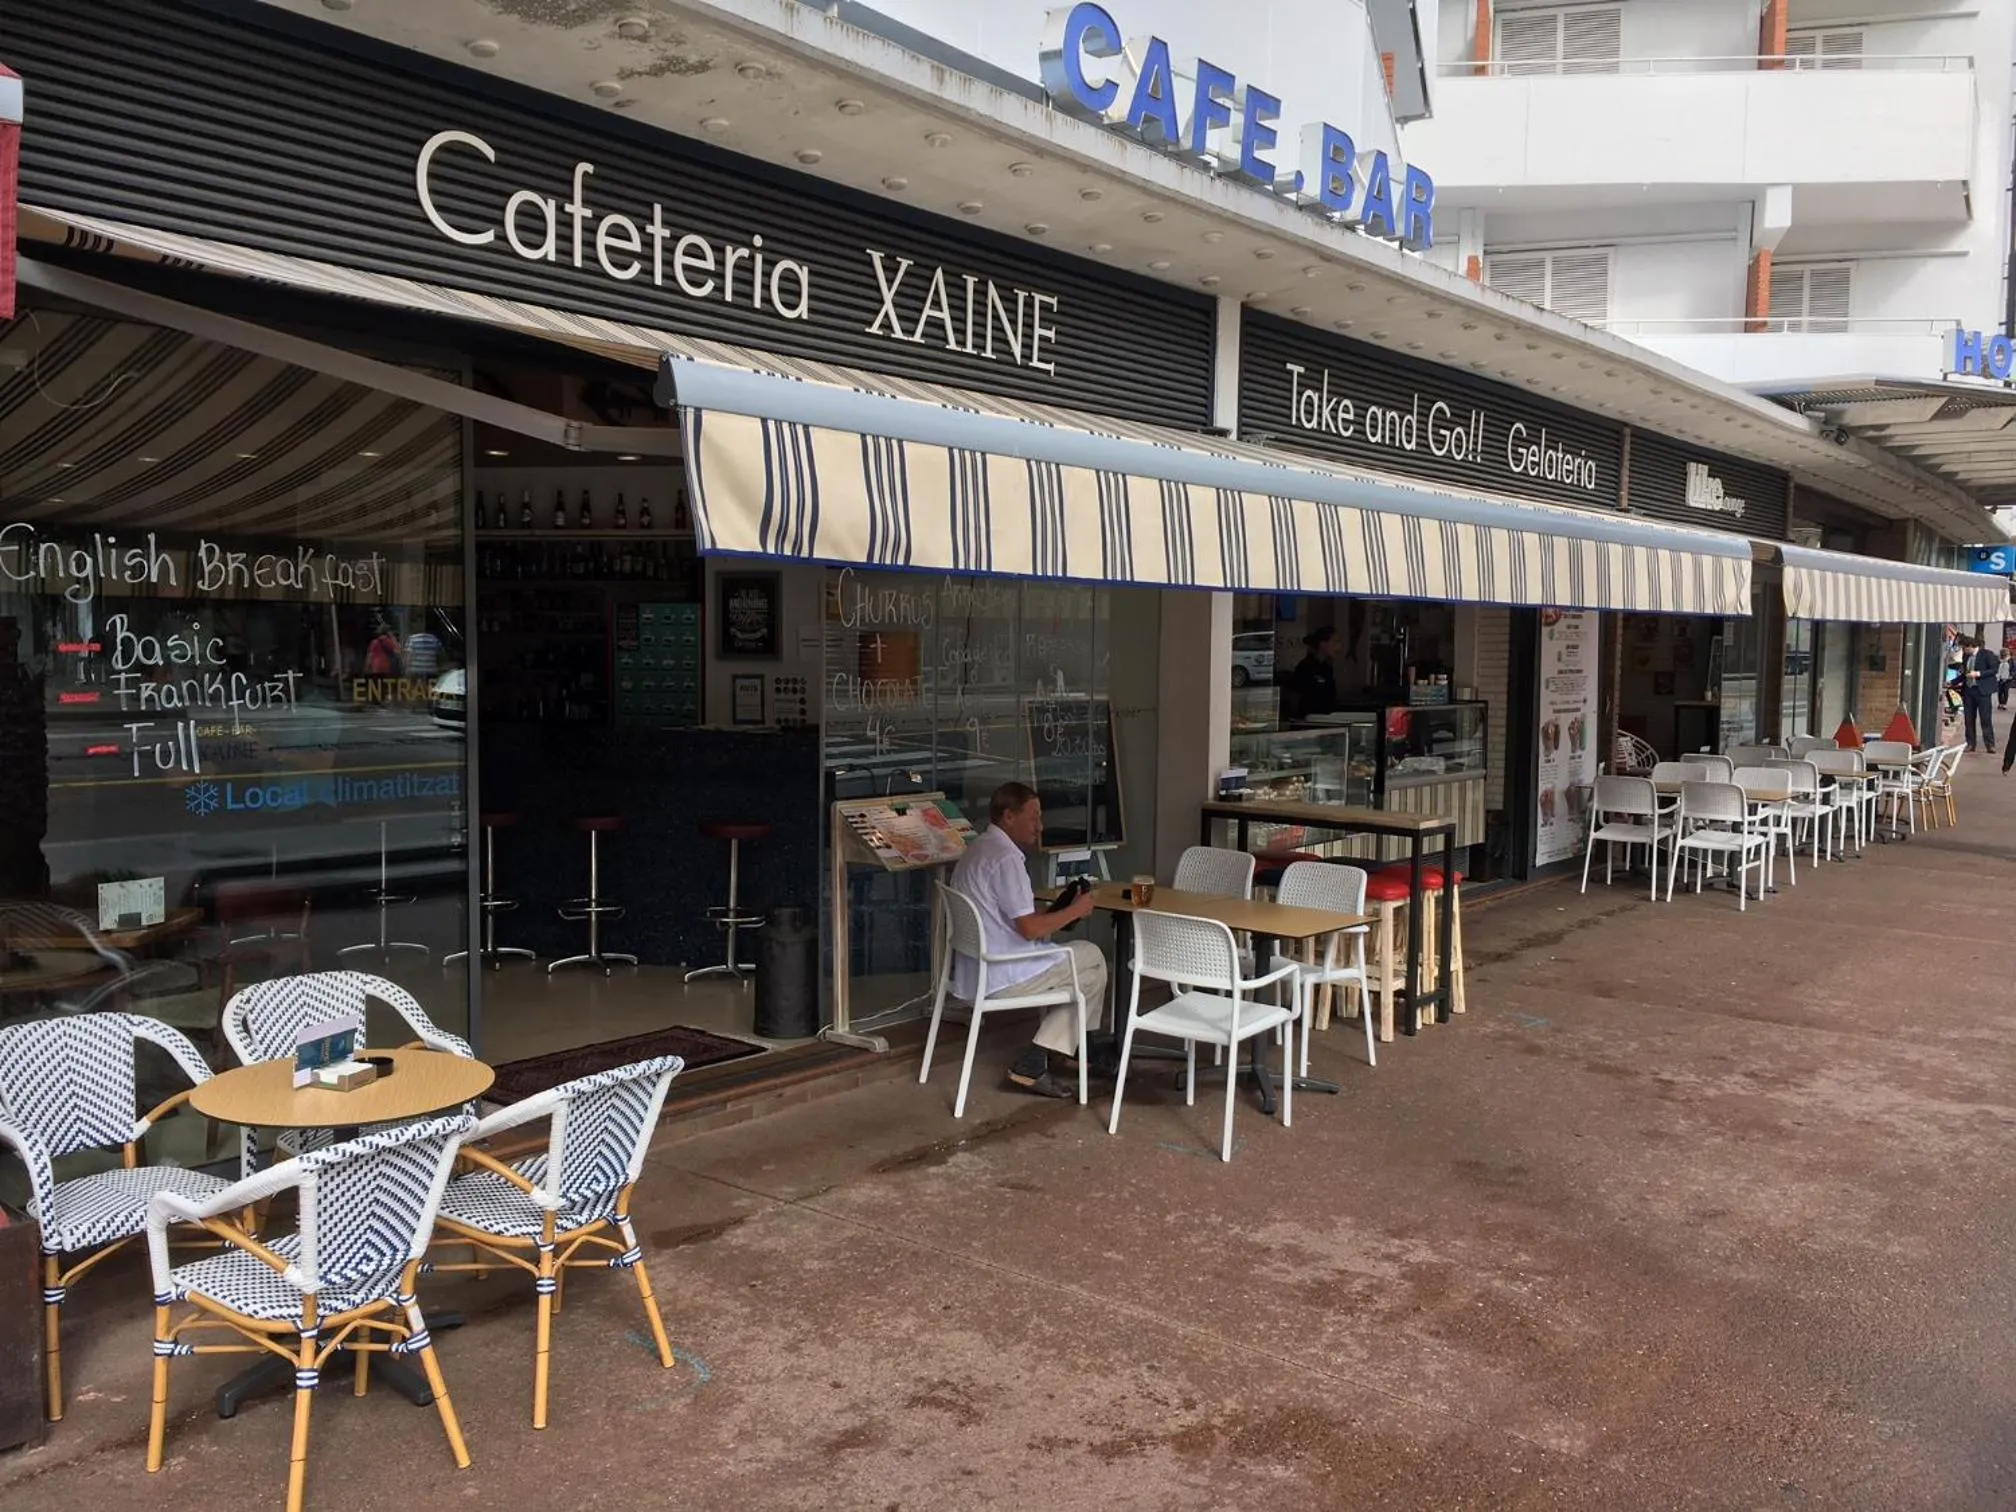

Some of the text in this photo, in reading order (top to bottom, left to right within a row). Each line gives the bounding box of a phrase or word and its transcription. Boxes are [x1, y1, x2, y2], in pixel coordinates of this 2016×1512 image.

[415, 130, 1059, 377] Cafeteria XAINE
[1286, 362, 1596, 490] Take and Go!! Gelateria
[0, 523, 177, 603] English
[106, 614, 227, 670] Basic
[123, 720, 201, 777] Full
[226, 779, 310, 811] Local
